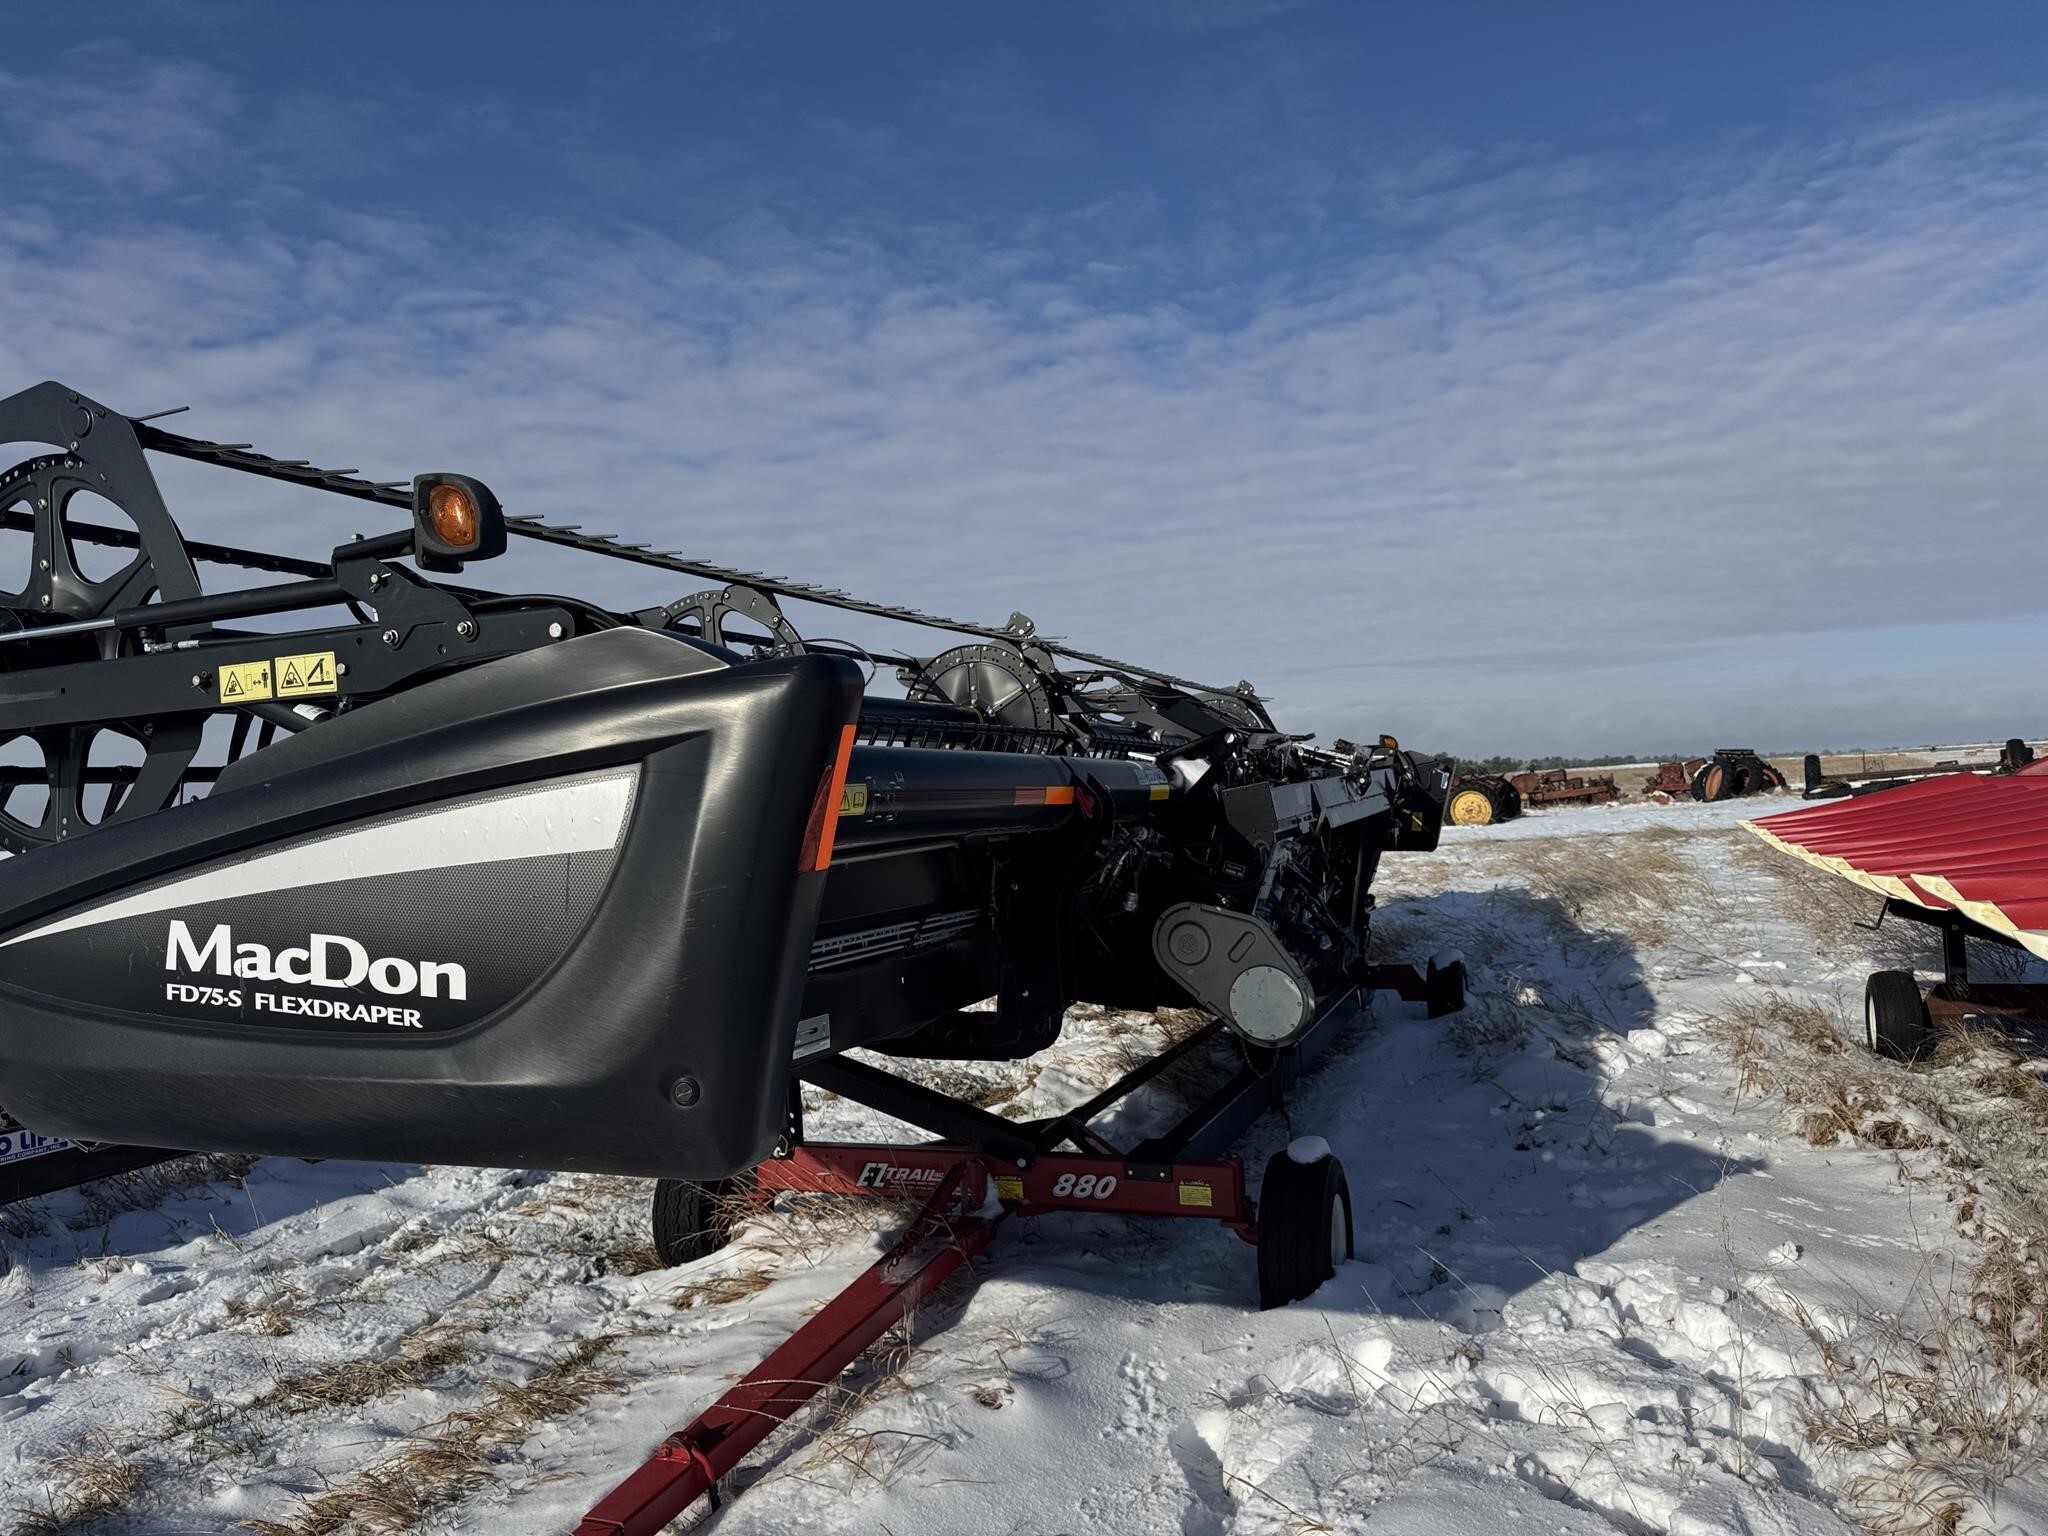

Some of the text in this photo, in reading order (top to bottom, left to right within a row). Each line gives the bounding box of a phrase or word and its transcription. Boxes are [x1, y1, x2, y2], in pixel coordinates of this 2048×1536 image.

[165, 919, 467, 1001] MacDon
[166, 983, 424, 1029] FD75-S FLEXDRAPER
[20, 1131, 59, 1149] LIF
[886, 1167, 942, 1182] TRAIL
[1052, 1173, 1118, 1200] 880
